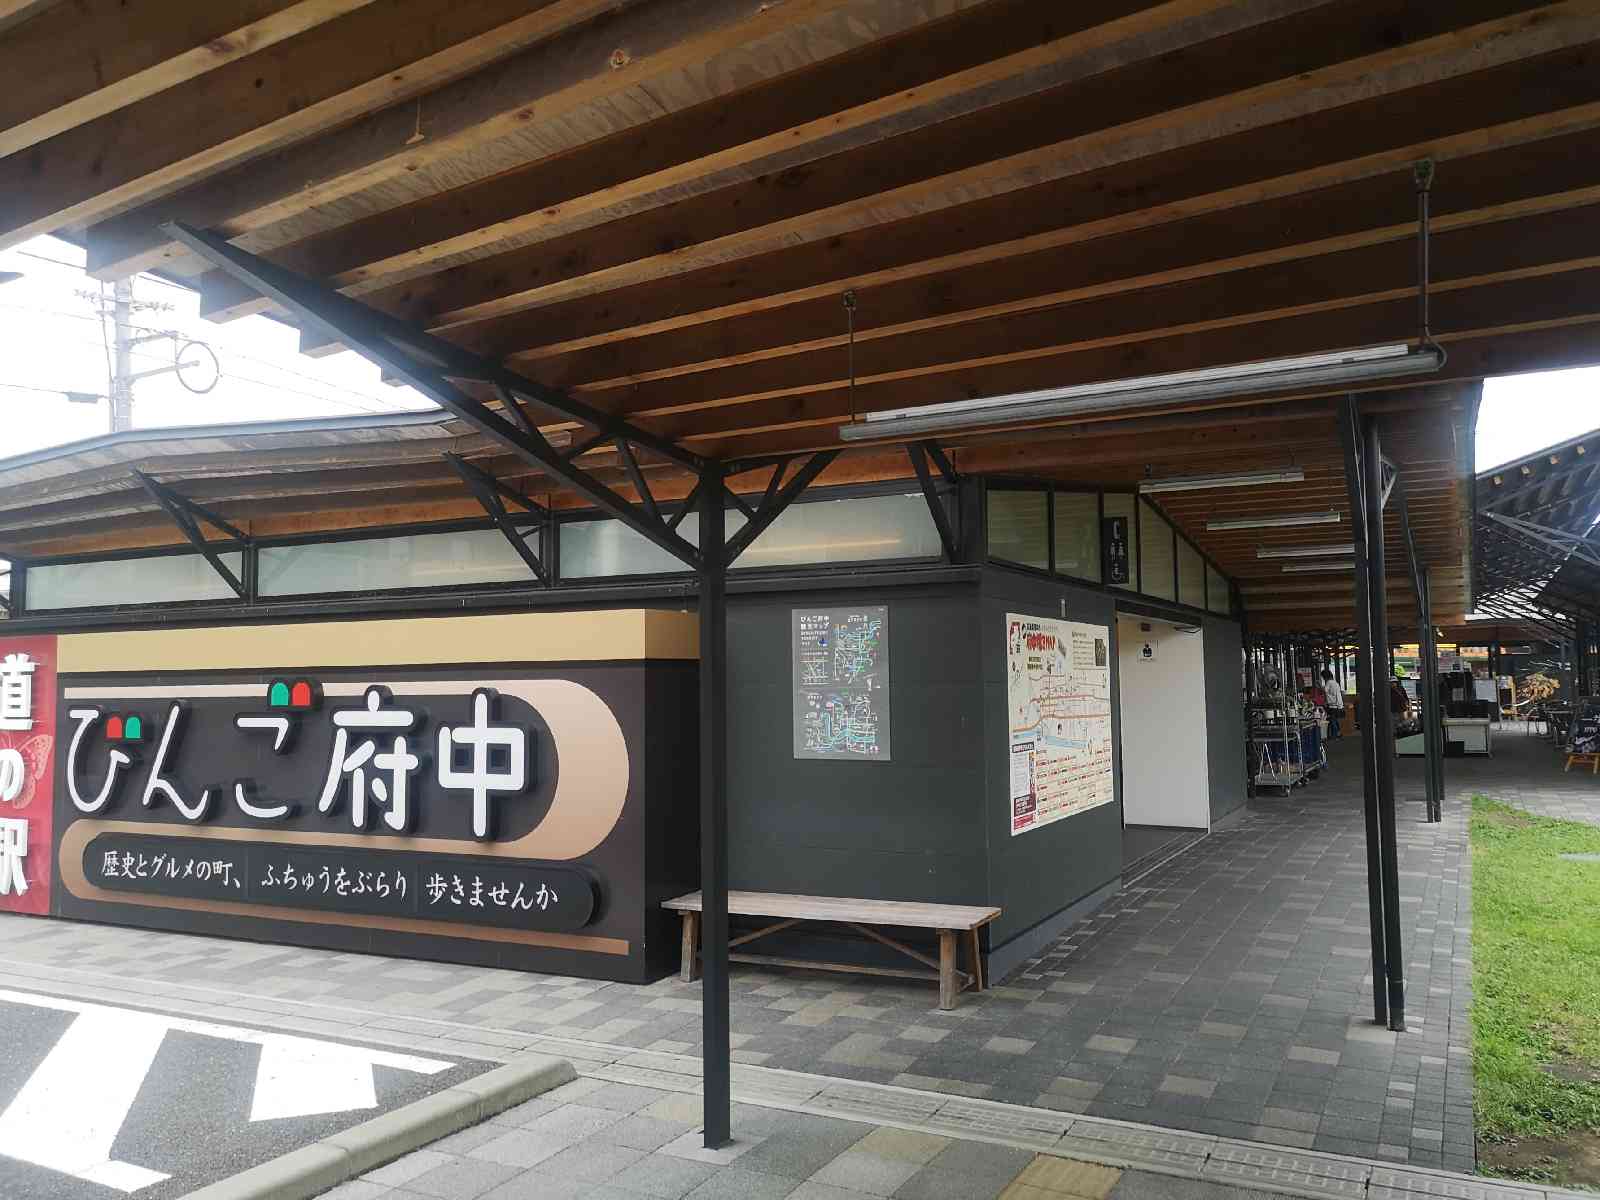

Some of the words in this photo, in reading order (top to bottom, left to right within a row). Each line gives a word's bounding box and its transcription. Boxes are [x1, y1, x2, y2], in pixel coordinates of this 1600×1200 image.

[67, 680, 526, 838] びんご府中
[101, 850, 242, 888] 歴史とグルメの町、
[261, 864, 408, 900] ふちゅうをぶらり
[425, 872, 559, 911] 歩きませんか
